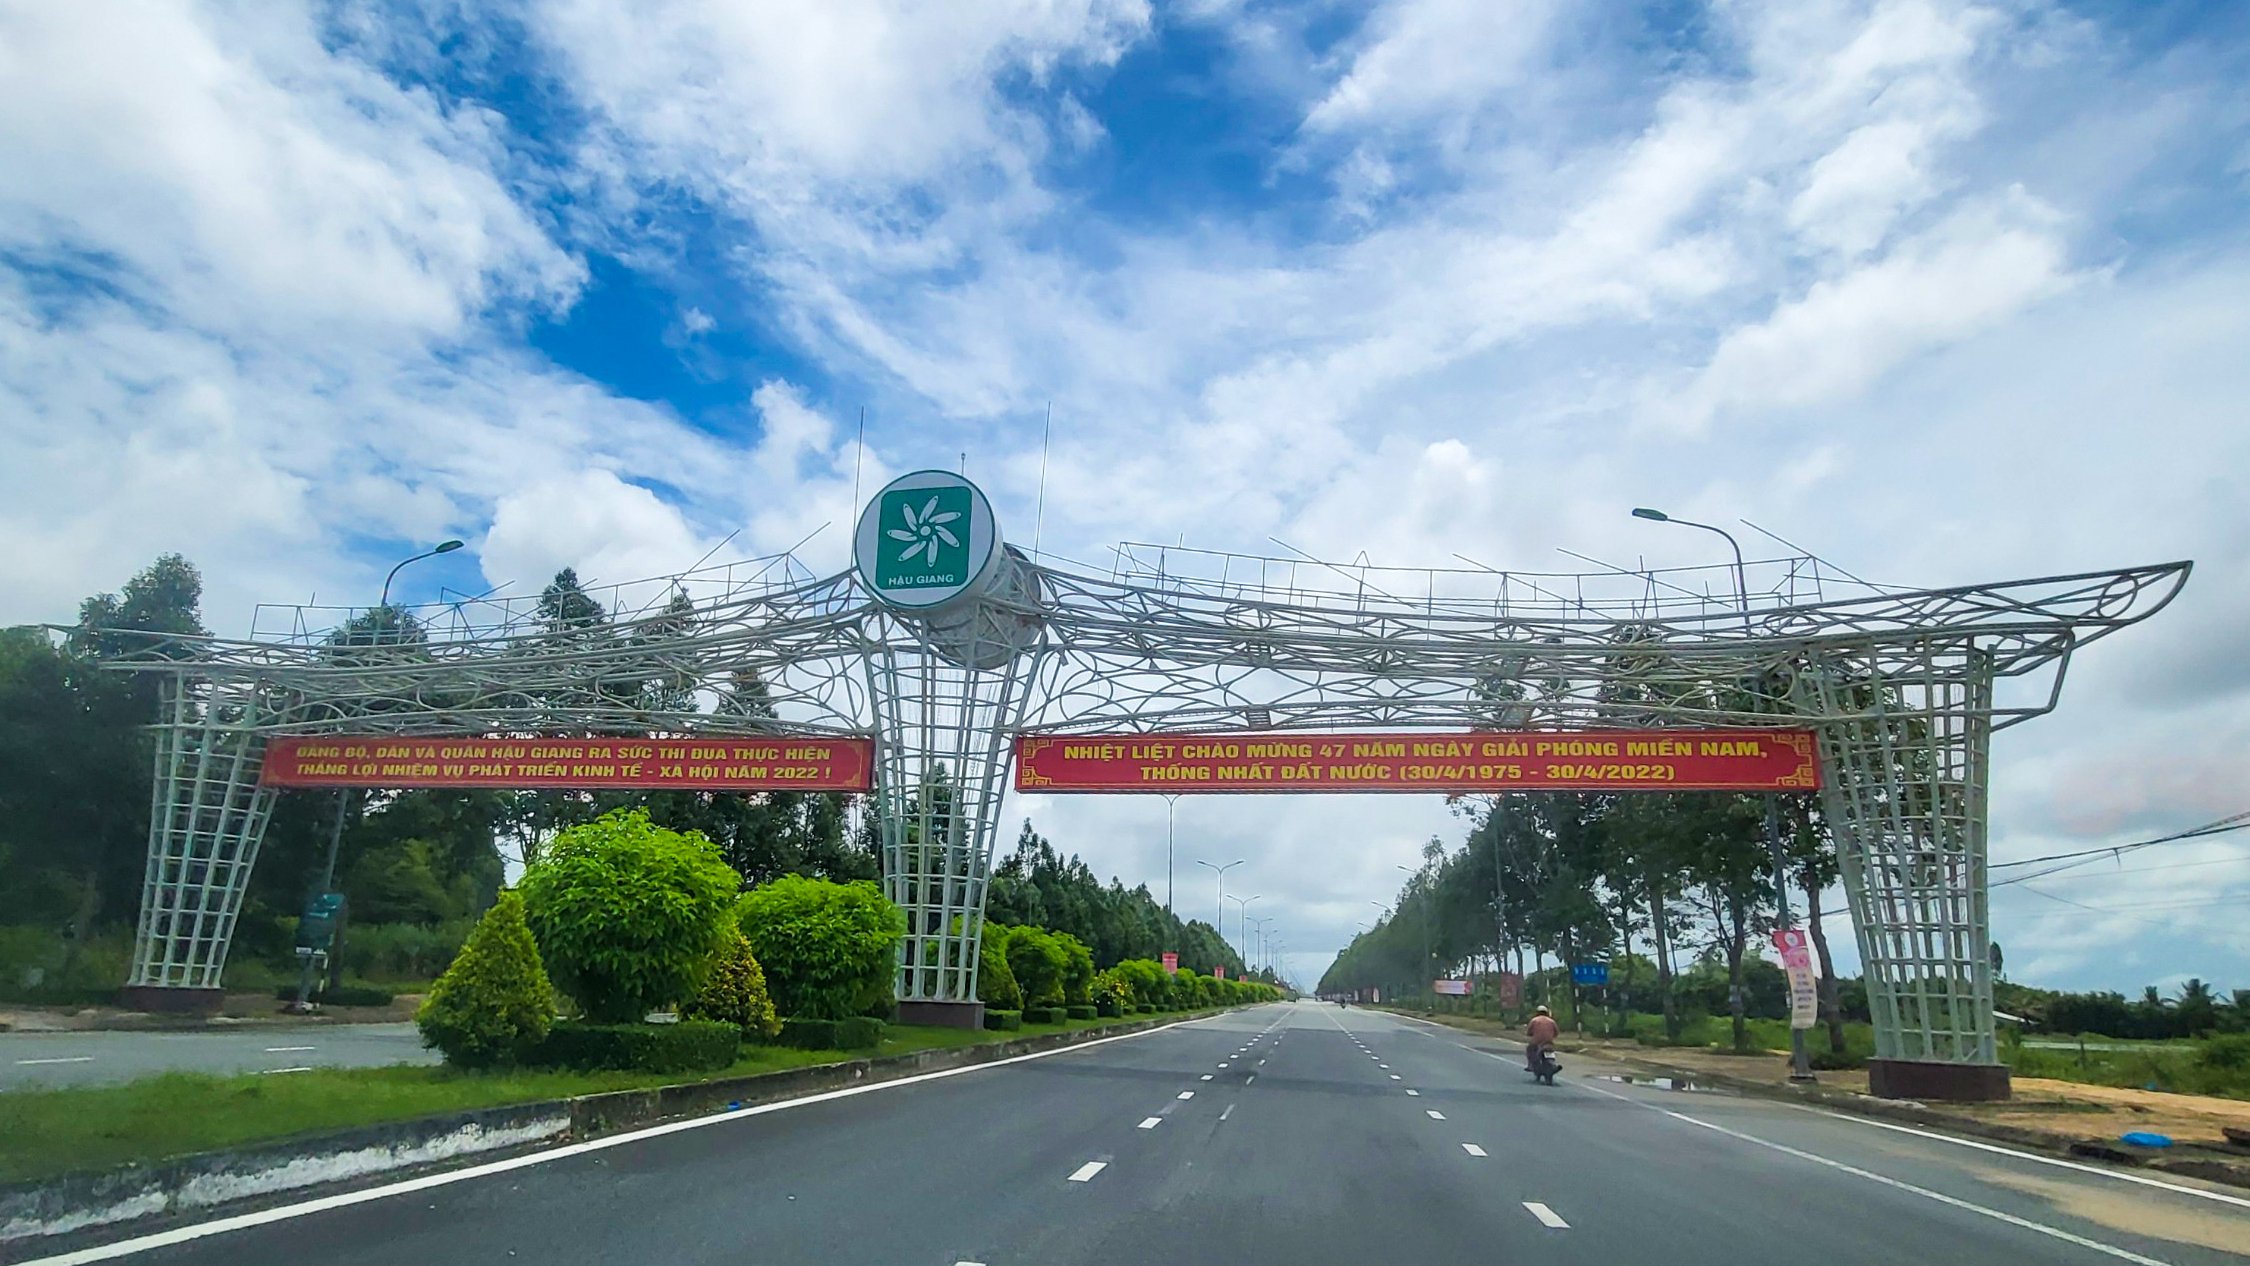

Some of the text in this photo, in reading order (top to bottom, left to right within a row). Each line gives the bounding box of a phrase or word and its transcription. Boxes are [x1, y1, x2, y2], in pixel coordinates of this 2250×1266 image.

[888, 574, 954, 587] HẬU GIANG
[376, 745, 410, 758] DÂN
[415, 745, 436, 758] VÀ
[441, 745, 487, 759] QUÂN
[491, 745, 526, 761] HẬU
[530, 747, 583, 759] GIANG
[588, 747, 612, 759] RA
[617, 744, 653, 759] SỨC
[658, 747, 686, 759] THI
[690, 748, 727, 760] ĐUA
[733, 746, 780, 763] THỰC
[785, 746, 831, 763] HIỆN
[1064, 743, 1126, 762] NHIỆT
[1131, 743, 1176, 762] LIỆT
[1182, 742, 1239, 759] CHÀO
[1246, 741, 1313, 758] MỪNG
[1319, 744, 1346, 758] 47
[1353, 741, 1405, 758] NĂM
[1413, 740, 1474, 757] NGÀY
[1482, 737, 1529, 757] GIẢI
[1536, 739, 1619, 757] PHÓNG
[1627, 737, 1693, 757] MIỀN
[352, 762, 378, 777] LỢI
[382, 763, 438, 778] NHIỆM
[443, 765, 464, 778] VỤ
[468, 763, 513, 777] PHÁT
[517, 760, 568, 777] TRIỂN
[572, 765, 615, 777] KINH
[621, 762, 643, 777] TẾ
[659, 763, 683, 778] XÃ
[688, 764, 719, 780] HỘI
[724, 765, 767, 779] NĂM
[773, 767, 819, 779] 2022
[825, 767, 831, 779] !
[1141, 762, 1211, 780] THỐNG
[1217, 762, 1274, 780] NHẤT
[1281, 762, 1322, 780] ĐẤT
[1329, 763, 1392, 780] NƯỚC
[1400, 765, 1522, 781] (30/4/1975
[1547, 764, 1674, 781] 30/4/2022)
